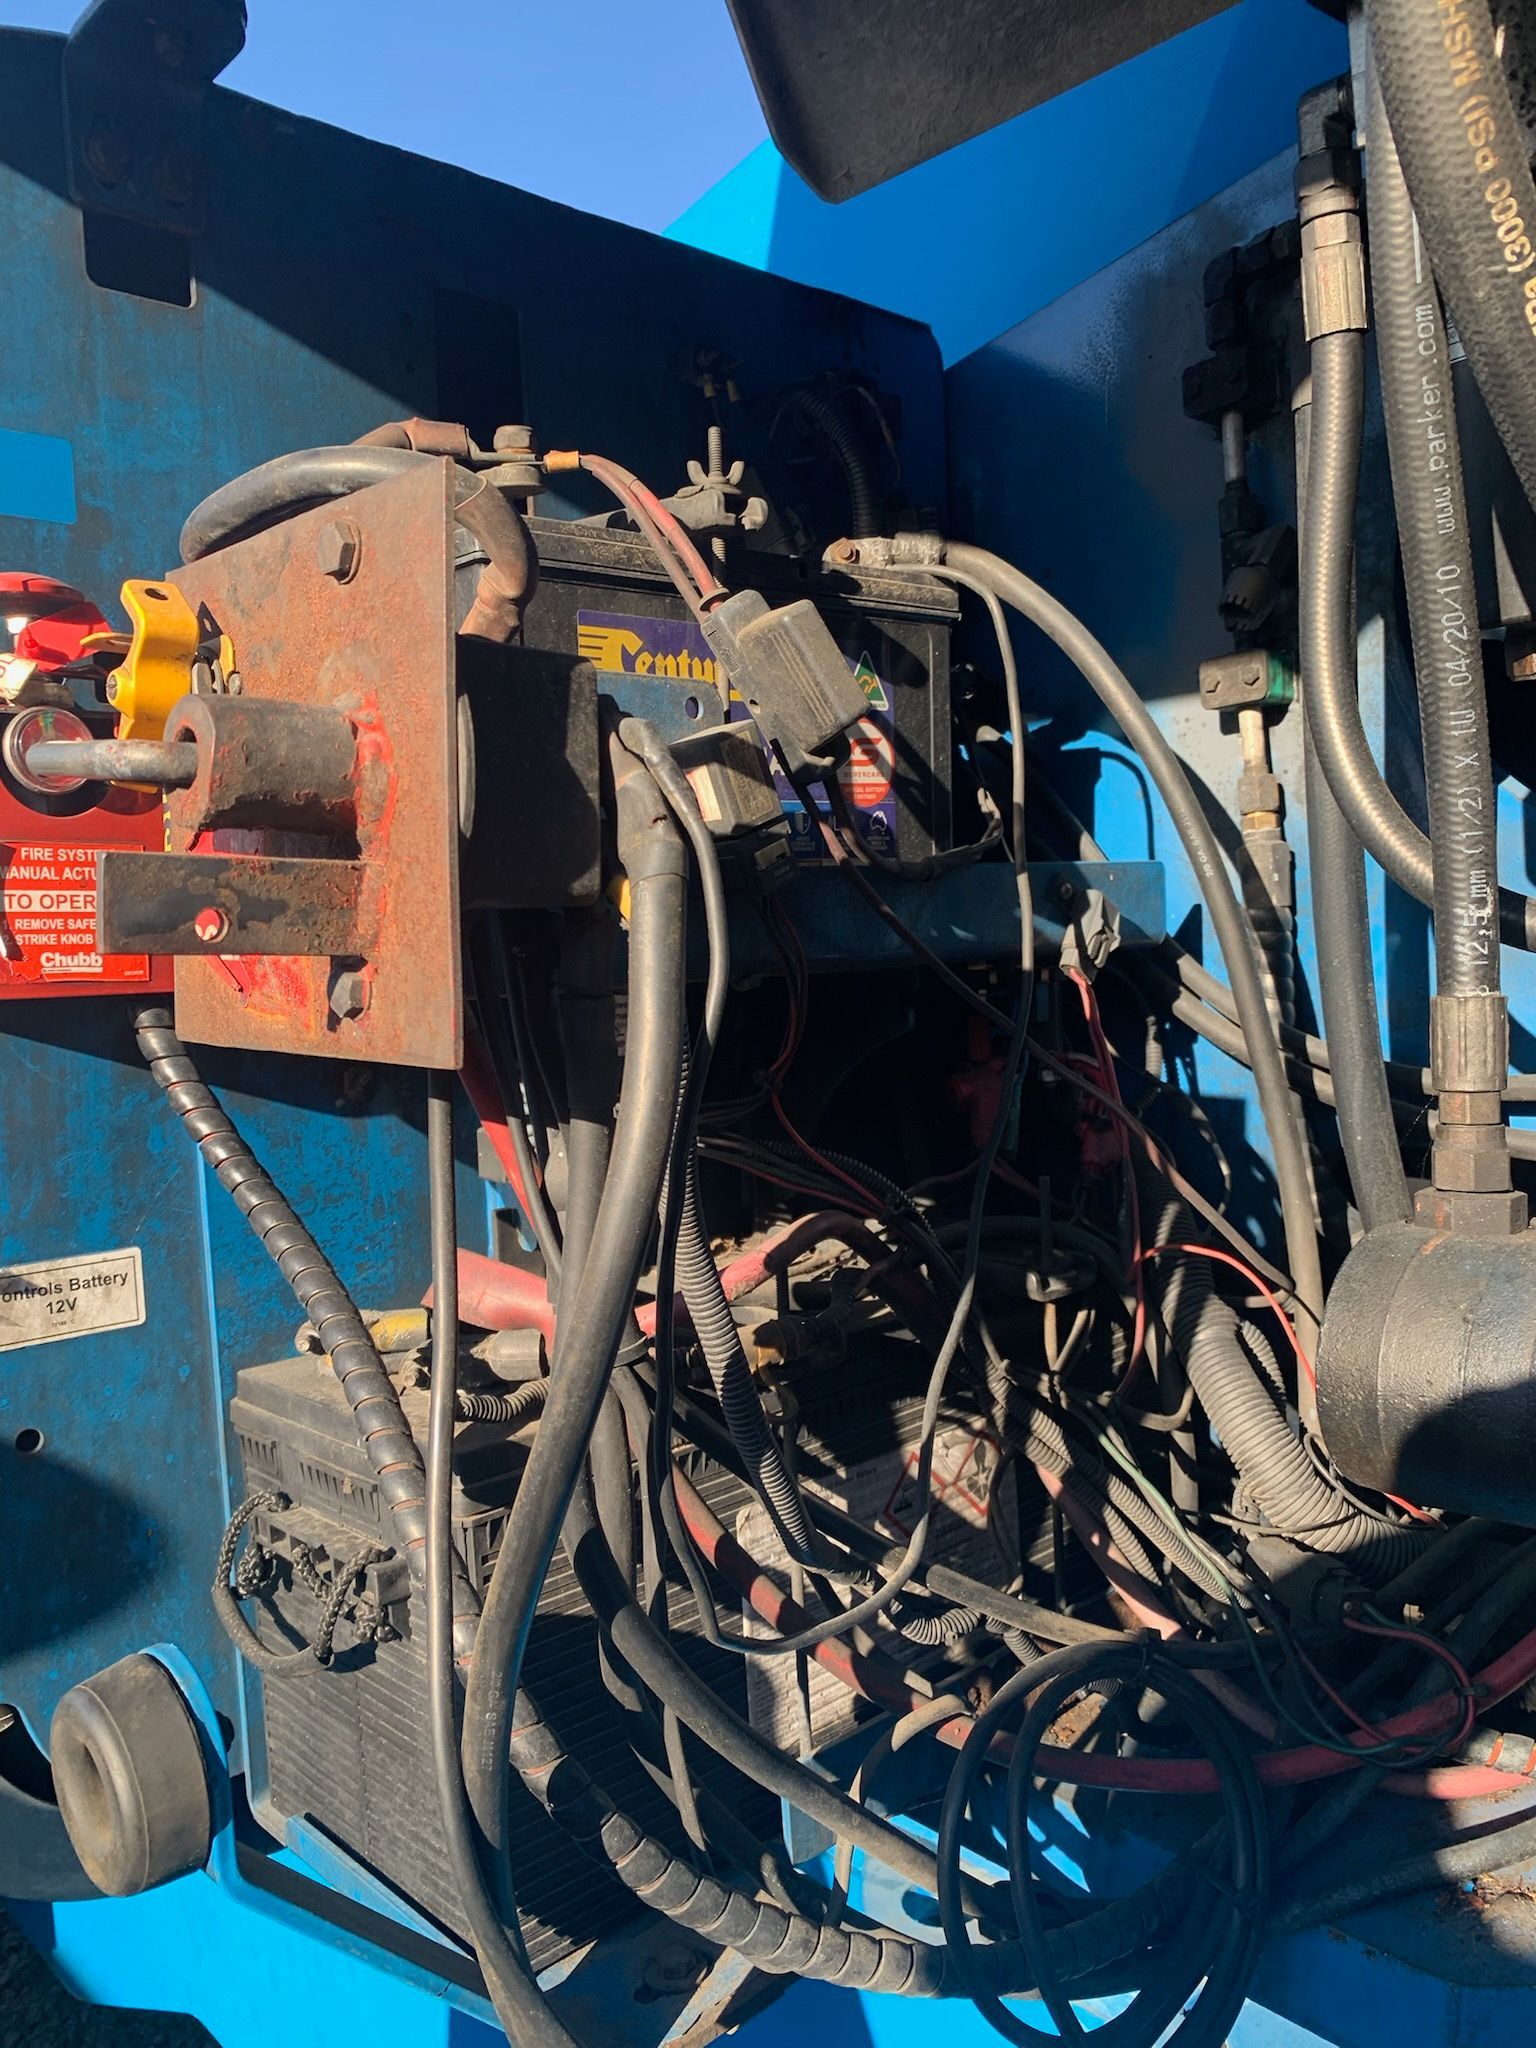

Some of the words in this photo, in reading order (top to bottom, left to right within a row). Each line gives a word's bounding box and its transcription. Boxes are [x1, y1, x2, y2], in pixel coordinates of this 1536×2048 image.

[1459, 95, 1499, 174] PSI)
[1485, 176, 1536, 273] (3000
[1415, 303, 1456, 535] www.parker.com
[1436, 564, 1473, 686] 04/20/10
[1455, 752, 1480, 769] X
[1457, 786, 1485, 855] (1/2)
[21, 848, 53, 861] FIRE
[1470, 869, 1487, 898] mm
[5, 894, 32, 909] TO
[15, 919, 64, 930] REMOVE
[15, 934, 57, 945] STRIKE
[61, 934, 93, 945] KNOB
[41, 952, 103, 967] Chubb
[69, 1272, 128, 1292] Battery
[46, 1297, 77, 1314] 12V
